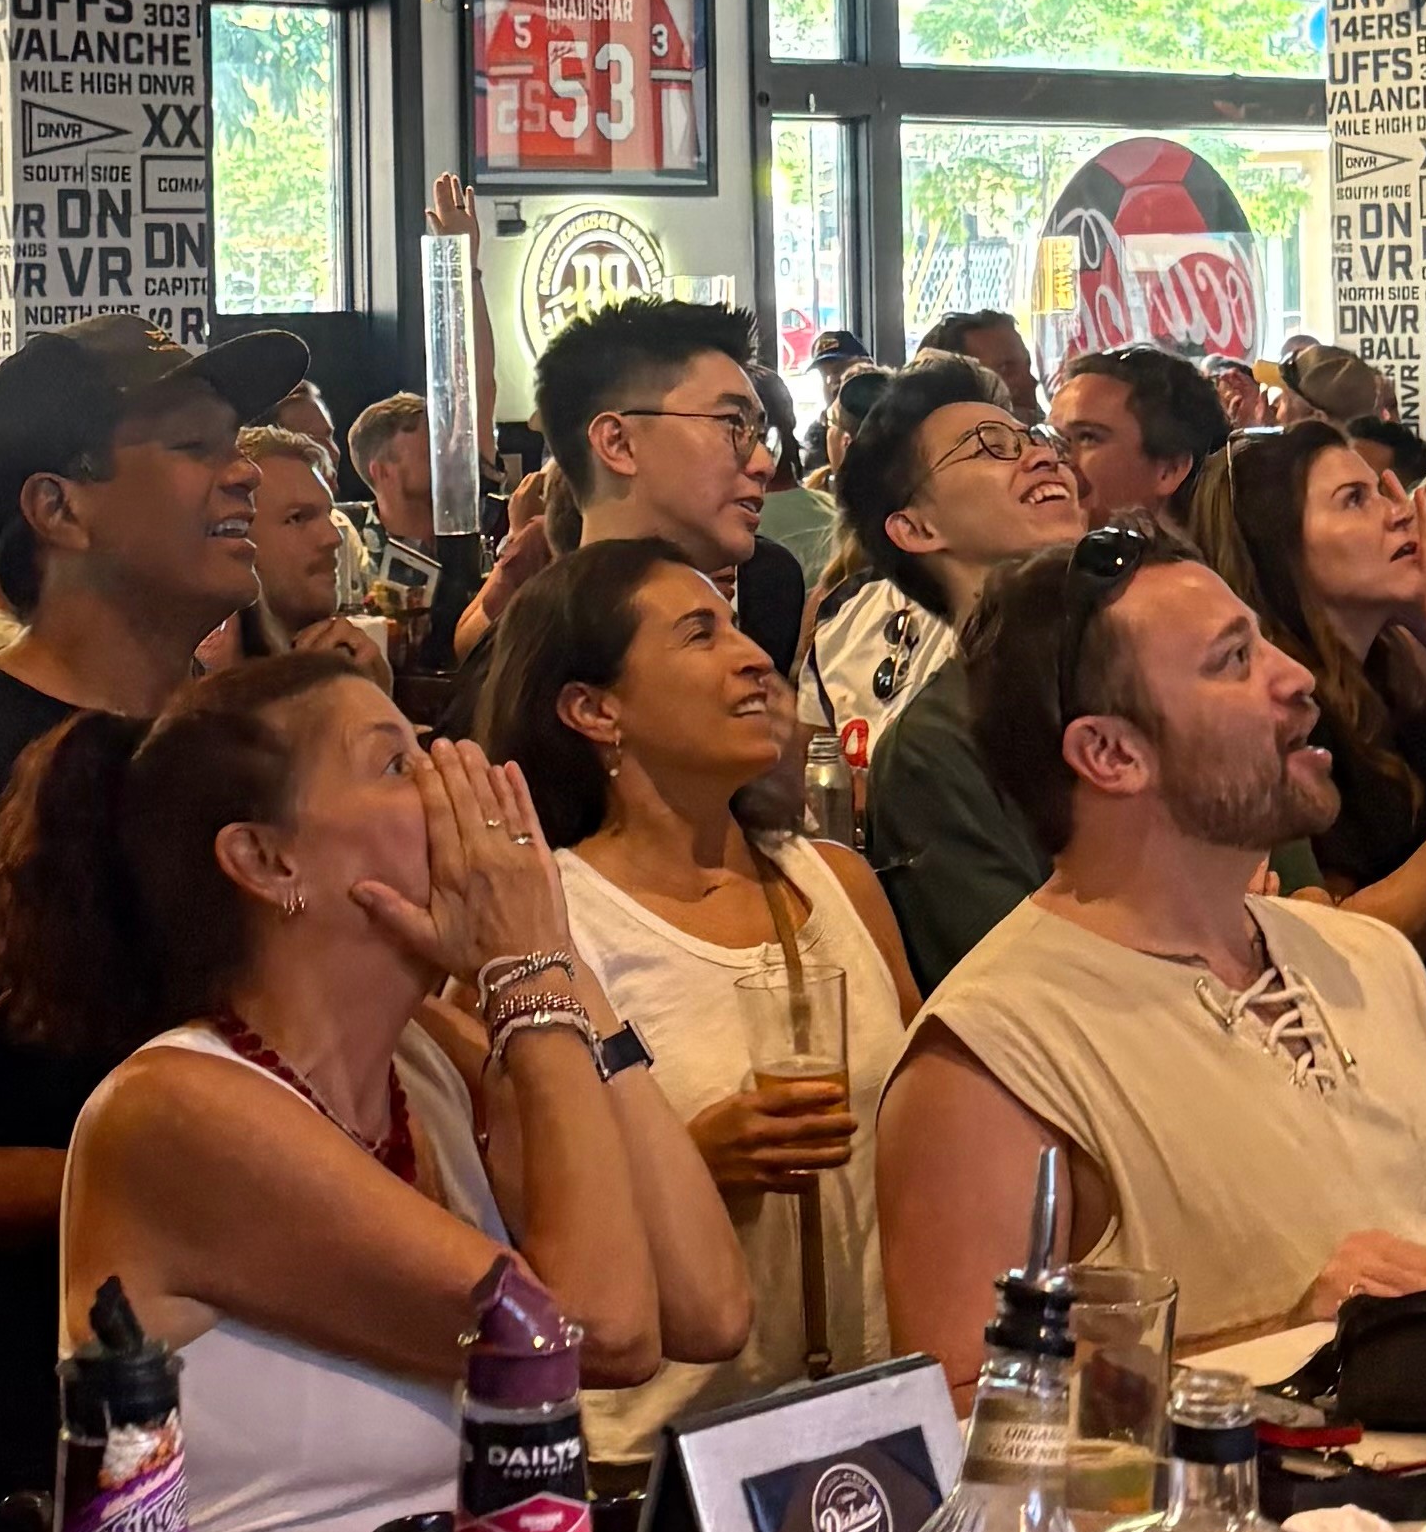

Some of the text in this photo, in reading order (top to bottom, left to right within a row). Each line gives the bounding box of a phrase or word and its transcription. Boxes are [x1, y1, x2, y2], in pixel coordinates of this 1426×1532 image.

[145, 5, 190, 28] 303
[1331, 12, 1411, 44] 14ERS
[513, 15, 531, 49] 5
[652, 24, 668, 57] 3
[20, 71, 195, 97] MILE HIGH DNVR
[548, 41, 635, 141] 53
[37, 122, 82, 140] DNVR
[1335, 119, 1370, 137] MILE
[1375, 116, 1412, 134] HIGH
[23, 165, 132, 183] SOUTH SIDE
[1337, 184, 1411, 200] SOUTH SIDE
[1339, 286, 1419, 301] NORTH SIDE
[1340, 305, 1419, 335] DNVR
[1360, 338, 1420, 360] BALL
